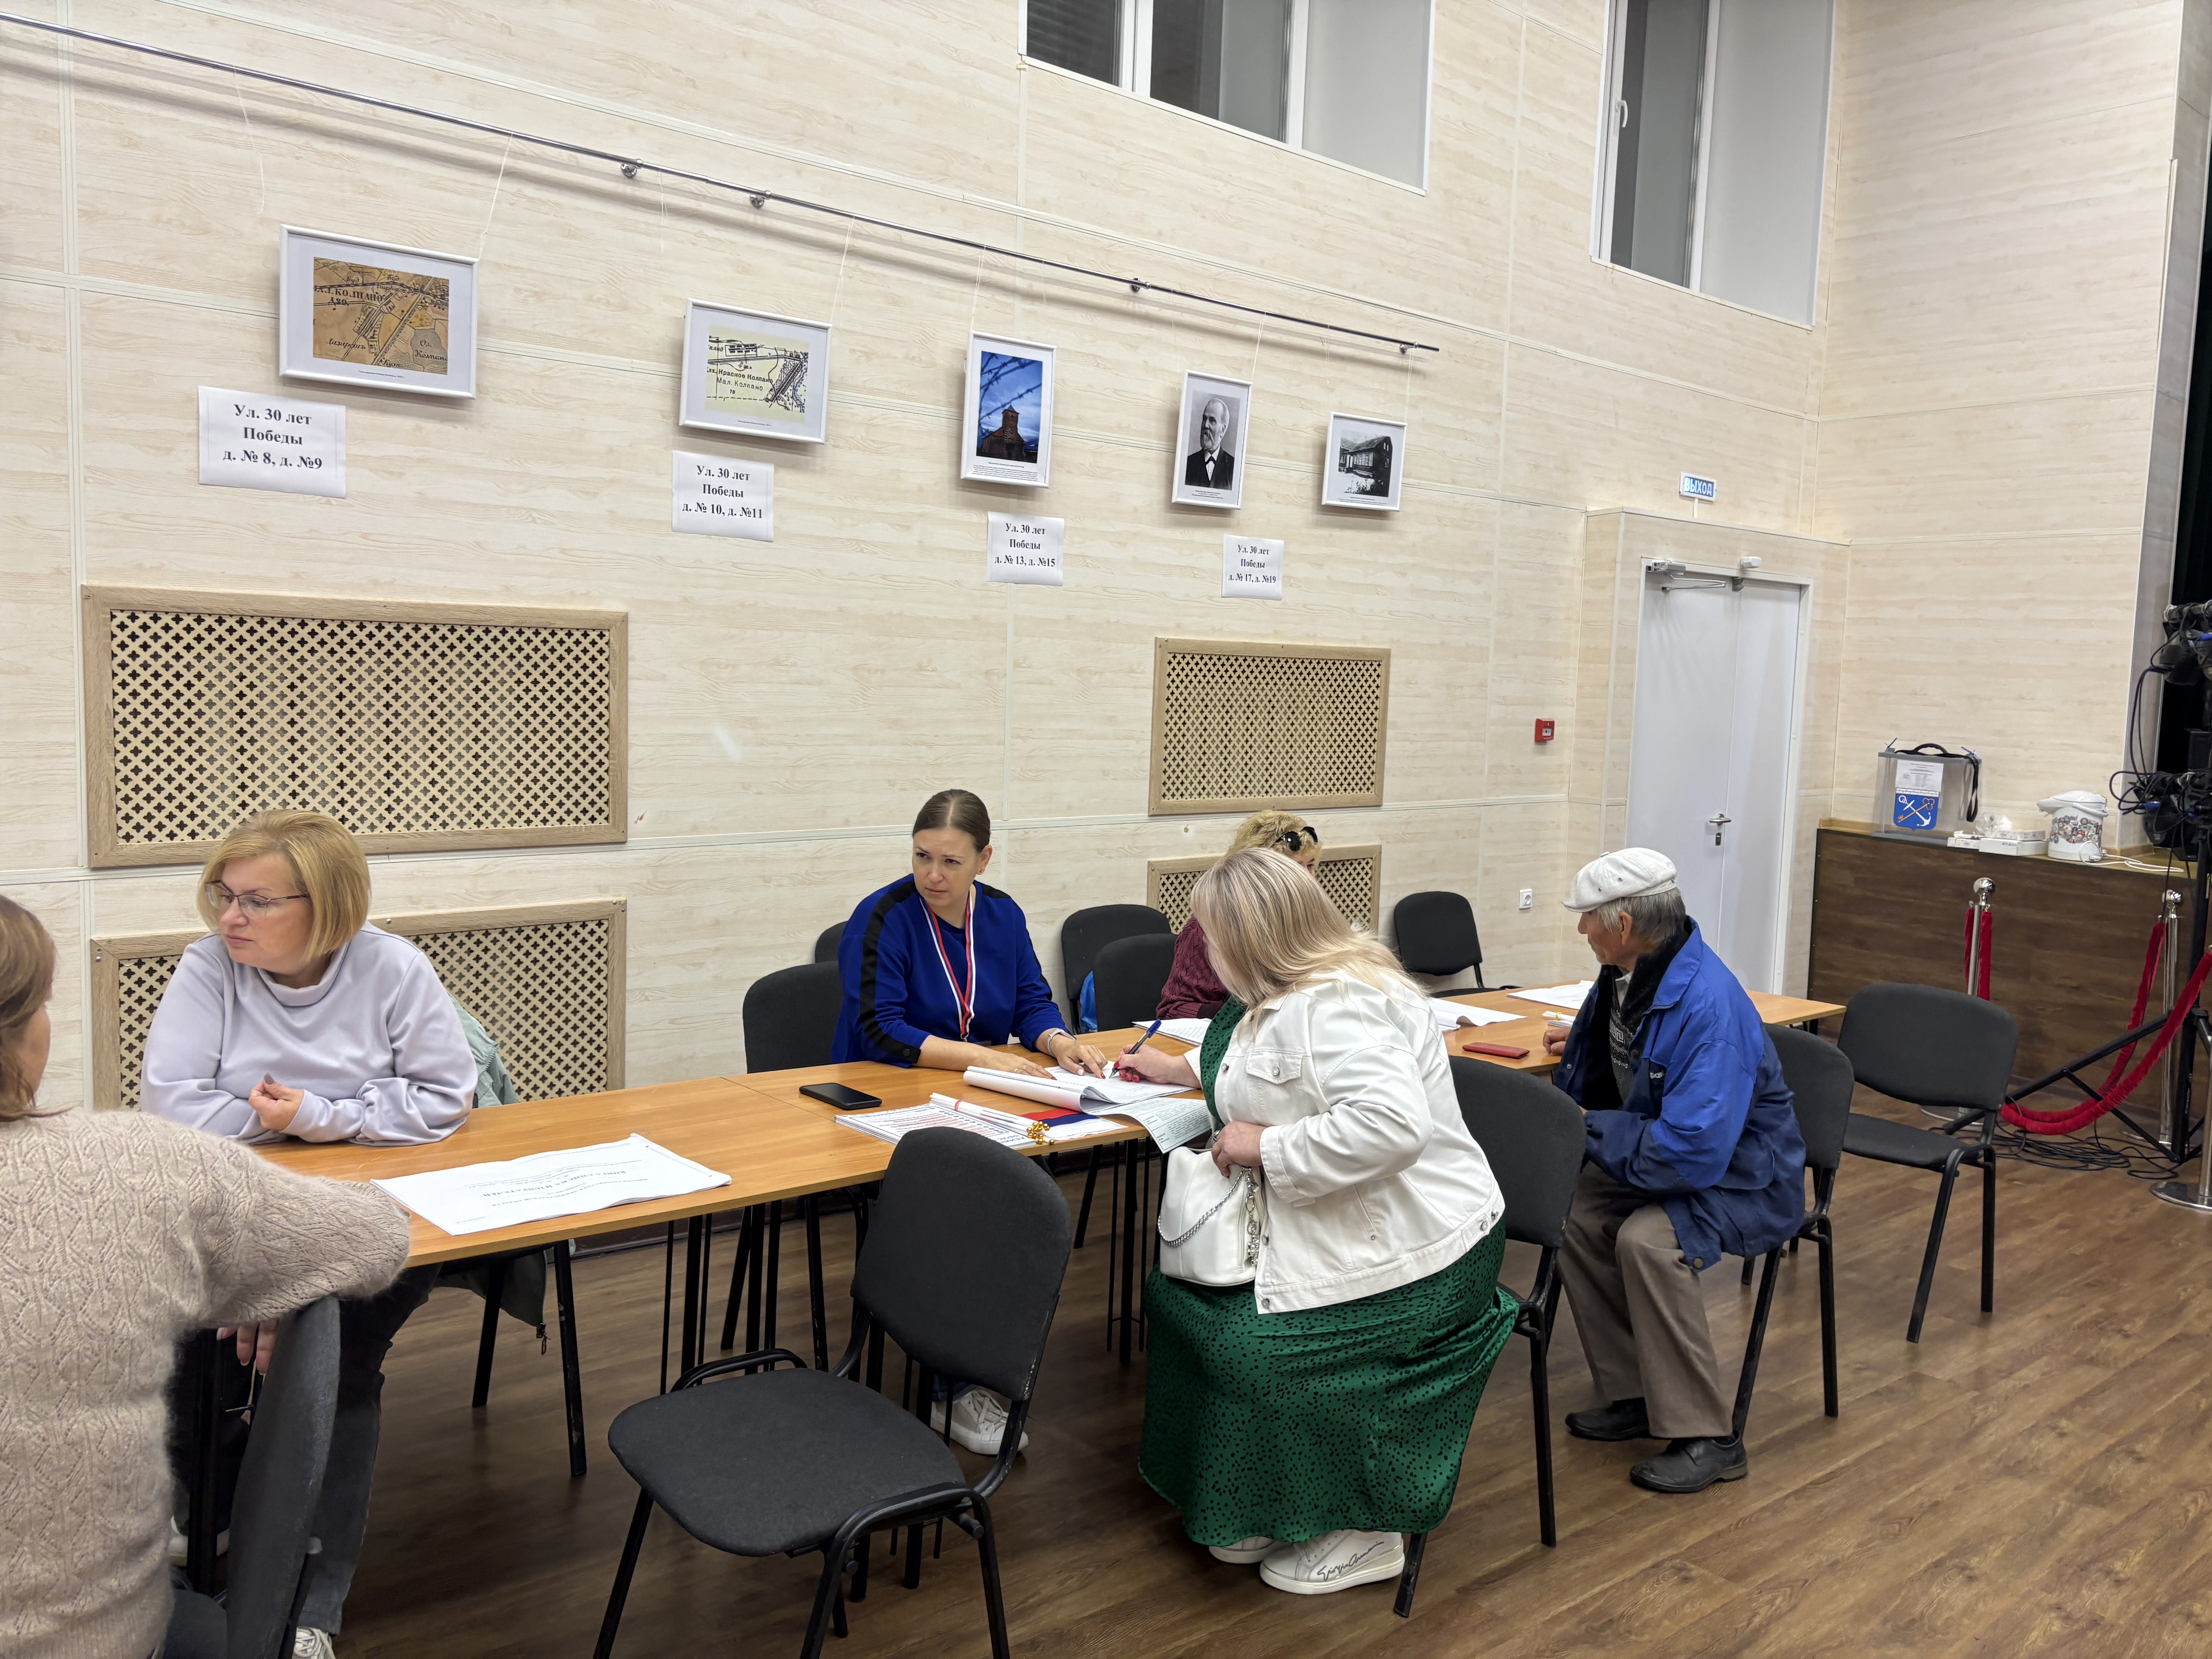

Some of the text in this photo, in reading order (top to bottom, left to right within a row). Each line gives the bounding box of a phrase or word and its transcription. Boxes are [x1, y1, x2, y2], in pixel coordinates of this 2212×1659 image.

[718, 368, 745, 379] Красное
[716, 377, 763, 391] Мал. Колпано
[234, 404, 312, 425] Ул. 30 лет
[243, 427, 303, 445] Победы
[223, 450, 323, 469] д. № 8, д. №9
[696, 465, 750, 481] Ул. 30 лет
[702, 483, 744, 498] Победы
[1684, 477, 1712, 496] ВЫХОД
[682, 502, 763, 519] д. № 10, д. №11
[1005, 523, 1018, 532] Ул.
[1020, 524, 1030, 534] 30
[1010, 539, 1041, 550] Победы
[1238, 544, 1248, 553] Ул.
[1249, 546, 1257, 554] 30
[1004, 555, 1013, 564] №
[1016, 556, 1027, 567] 13,
[1037, 557, 1055, 567] №15
[1241, 558, 1265, 568] Победы
[1235, 573, 1243, 581] №
[1245, 574, 1254, 583] 17,
[1262, 575, 1276, 583] №19
